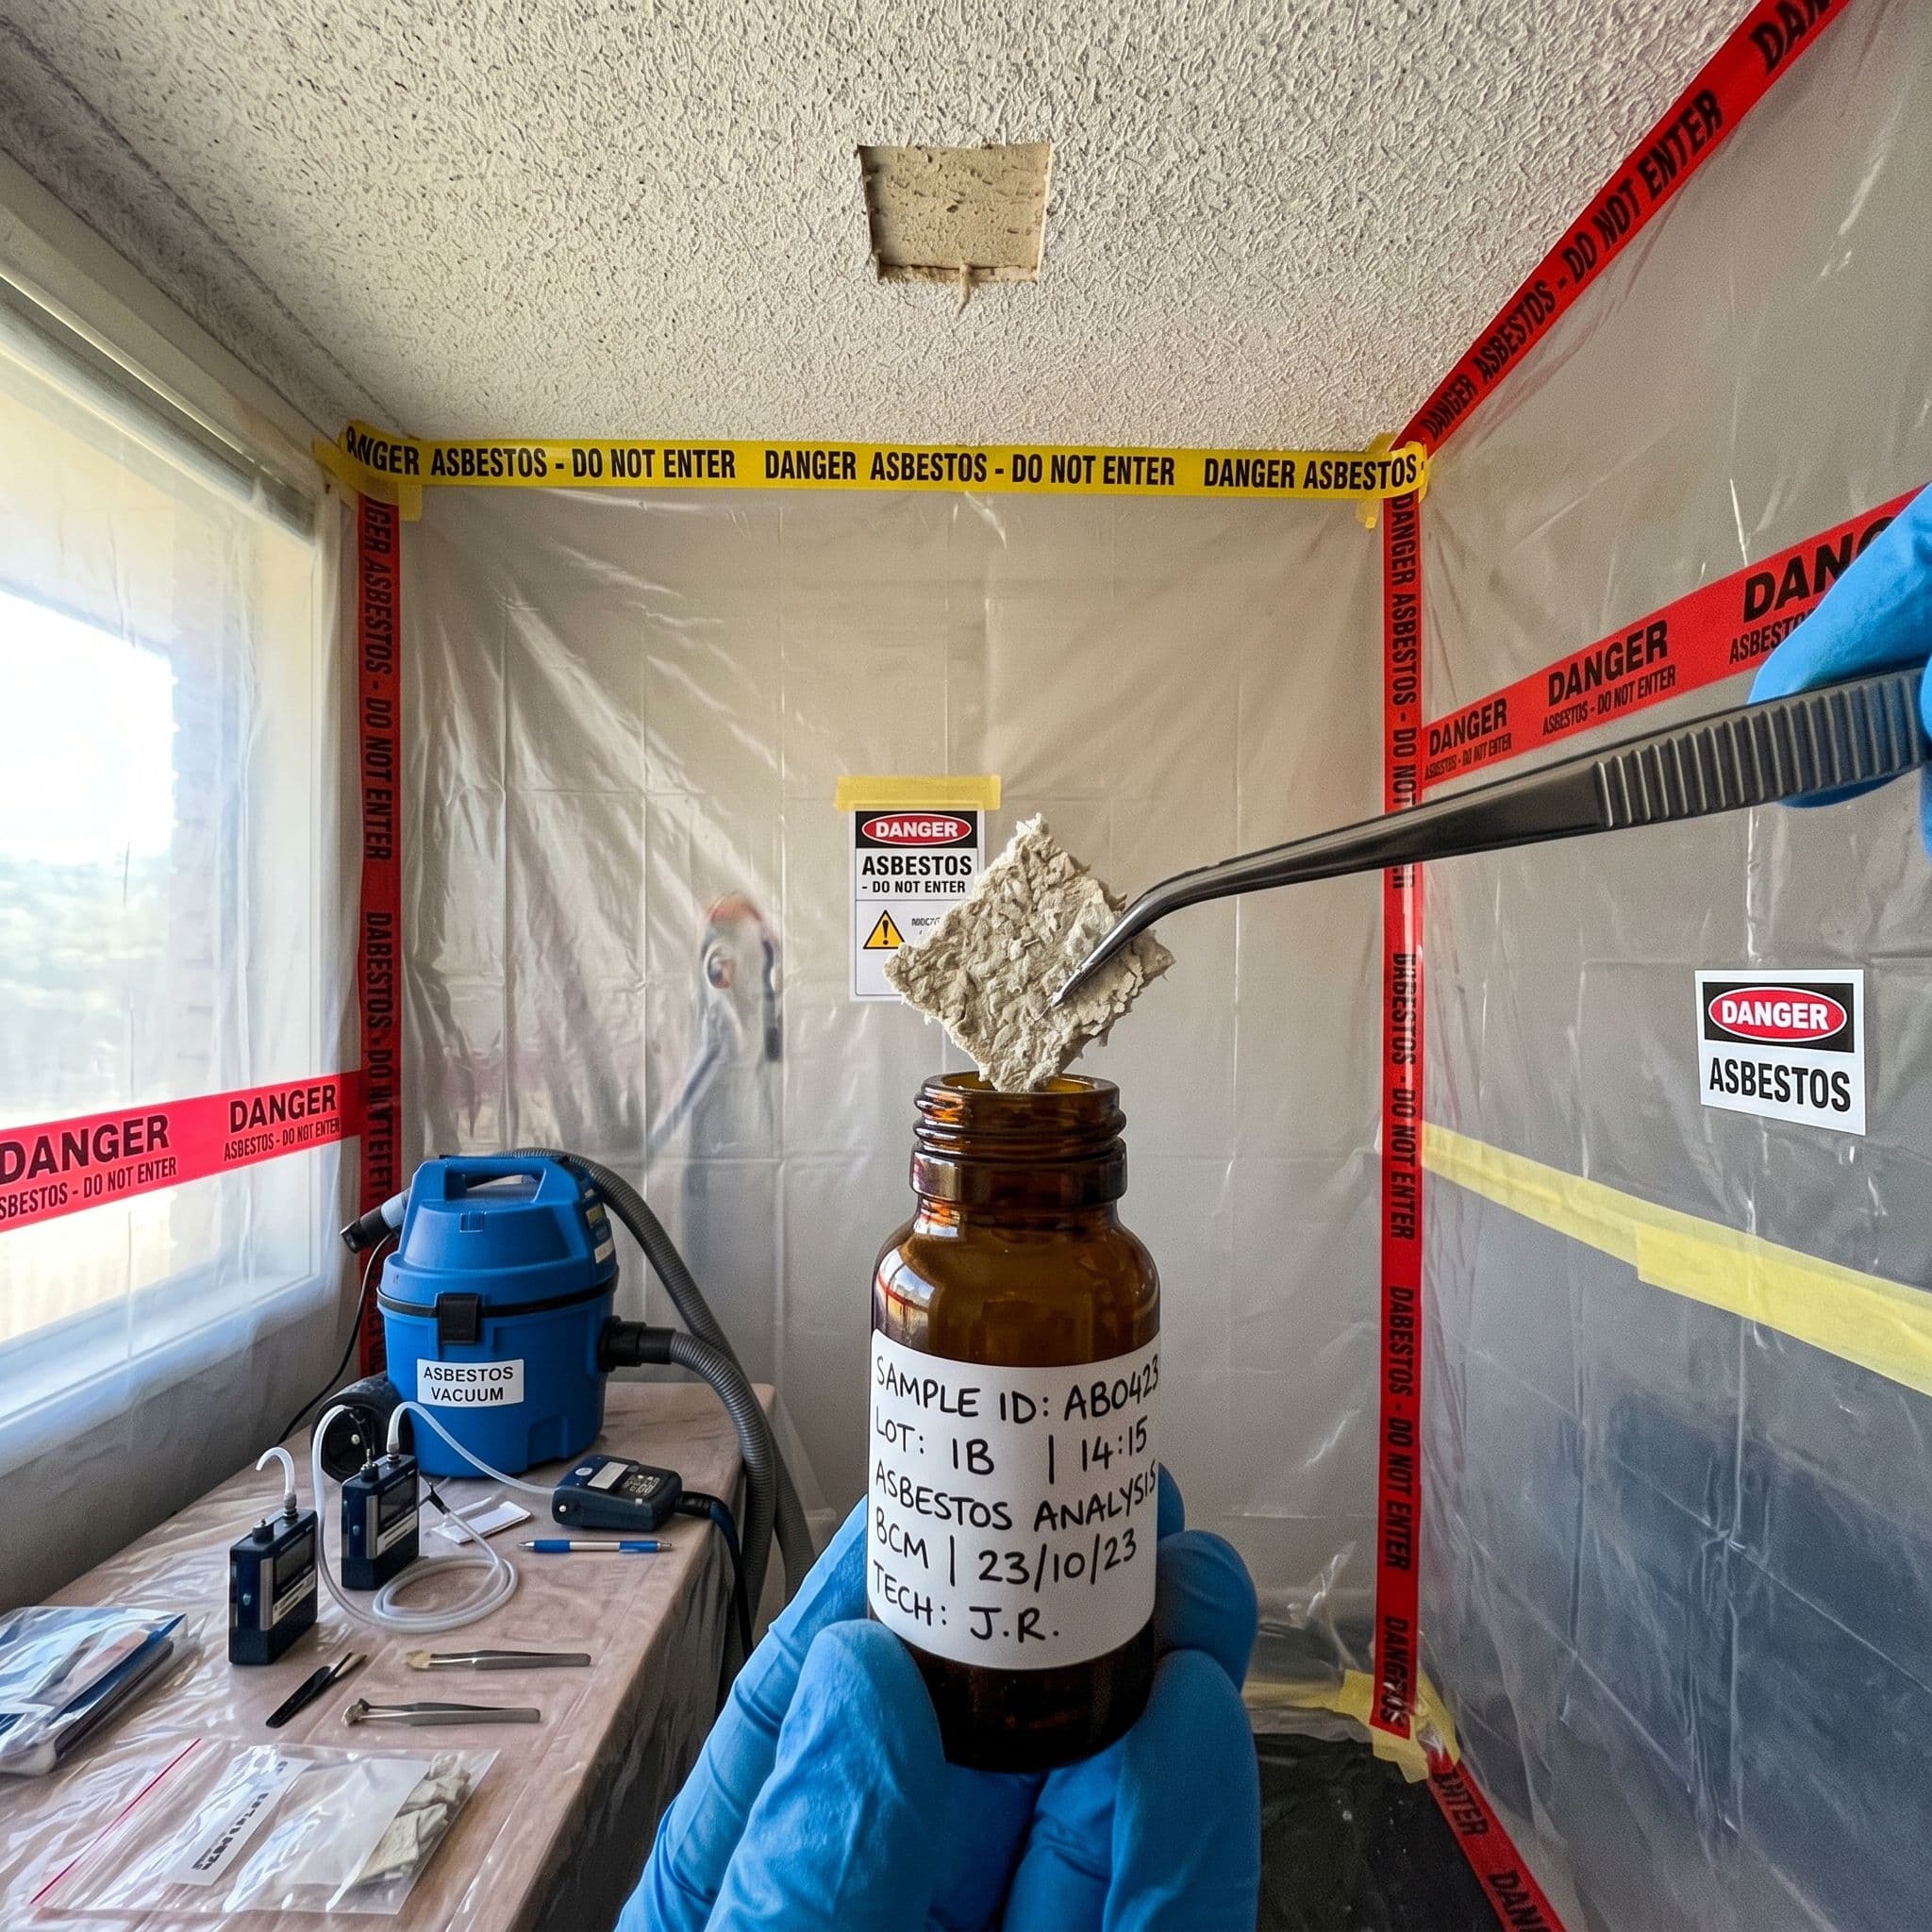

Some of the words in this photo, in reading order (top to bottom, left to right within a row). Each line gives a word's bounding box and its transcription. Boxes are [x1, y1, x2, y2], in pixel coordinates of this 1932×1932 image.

[1420, 375, 1478, 441] DANGER
[1473, 279, 1557, 384] ASBESTOS
[1563, 231, 1598, 284] DO
[1591, 177, 1642, 250] NOT
[1637, 89, 1724, 200] ENTER
[430, 447, 547, 476] ASBESTOS
[572, 447, 604, 478] DO
[611, 448, 656, 478] NOT
[663, 448, 737, 479] ENTER
[764, 449, 857, 480] DANGER
[870, 452, 988, 482] ASBESTOS
[1011, 453, 1043, 483] DO
[1050, 454, 1096, 485] NOT
[1103, 456, 1175, 486] ENTER
[1204, 457, 1295, 489] DANGER
[1303, 454, 1416, 490] ASBESTOS
[1391, 491, 1416, 586] DANGER
[364, 556, 392, 675] ASBESTOS
[1729, 608, 1816, 666] ASBEST
[1391, 592, 1417, 706] ASBESTOS
[1547, 619, 1669, 707] DANGER
[365, 696, 392, 729] DO
[1597, 686, 1612, 713] DO
[1613, 679, 1636, 707] NOT
[1637, 664, 1676, 702] ENTER
[1392, 726, 1417, 758] DO
[1428, 697, 1507, 757] DANGER
[365, 735, 393, 783] NOT
[1391, 764, 1417, 806] NOT
[365, 788, 393, 861] ENTER
[875, 821, 958, 838] DANGER
[862, 856, 973, 875] ASBESTOS
[872, 881, 891, 893] DO
[895, 881, 921, 893] NOT
[924, 881, 966, 893] ENTER
[1722, 1000, 1829, 1031] DANGER
[229, 1084, 337, 1133] DANGER
[1391, 1088, 1416, 1119] DO
[1709, 1057, 1851, 1112] ASBESTOS
[0, 1115, 170, 1185] DANGER
[224, 1137, 275, 1162] ASBESTOS
[282, 1127, 295, 1147] DO
[297, 1123, 314, 1142] NOT
[316, 1117, 341, 1138] ENTER
[1391, 1124, 1416, 1167] NOT
[84, 1176, 103, 1199] DO
[108, 1168, 134, 1193] NOT
[138, 1157, 177, 1184] ENTER
[1391, 1171, 1416, 1241] ENTER
[424, 1366, 514, 1382] ASBESTOS
[431, 1387, 504, 1403] VACUUM
[876, 1356, 981, 1417] SAMPLE
[999, 1391, 1049, 1424] ID:
[875, 1406, 925, 1454] LOT:
[1081, 1416, 1148, 1473] 14:15
[1388, 1417, 1414, 1447] DO
[875, 1458, 1013, 1531] ASBESTOS
[1034, 1458, 1157, 1532] ANALYSIS
[1387, 1452, 1413, 1498] NOT
[875, 1507, 929, 1570] BCM
[977, 1527, 1138, 1593] 23/10/23
[1384, 1499, 1412, 1571] ENTER
[874, 1559, 948, 1626] TECH:
[969, 1606, 1059, 1643] J.R.
[1487, 1870, 1551, 1932] DAN
